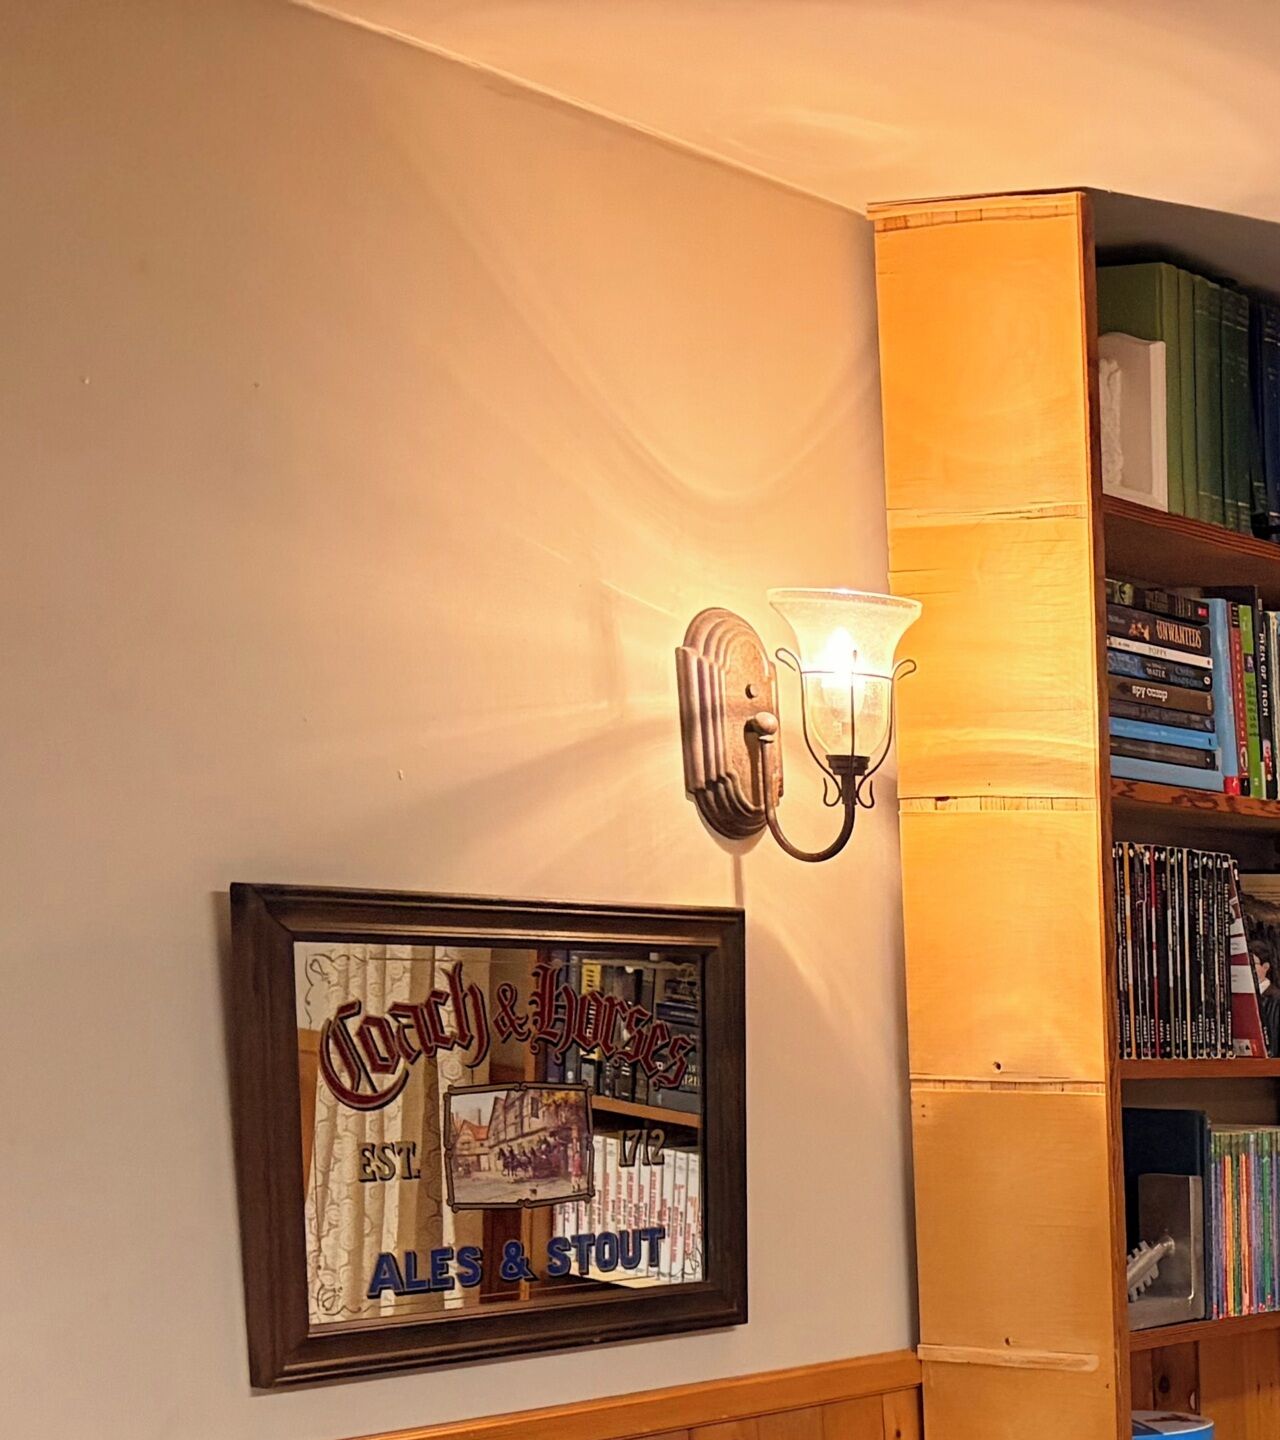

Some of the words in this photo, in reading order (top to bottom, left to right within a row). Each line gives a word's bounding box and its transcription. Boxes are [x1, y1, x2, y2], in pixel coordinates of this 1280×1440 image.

[1258, 632, 1266, 661] MEN
[1260, 665, 1267, 679] OF
[1261, 684, 1269, 717] IRON
[318, 962, 489, 1110] Coach
[496, 981, 532, 1044] &
[527, 962, 699, 1090] Horses
[357, 1140, 421, 1183] EST.
[617, 1128, 666, 1167] 1712
[366, 1246, 484, 1299] ALES
[500, 1239, 538, 1283] &
[546, 1226, 666, 1277] STOUT
